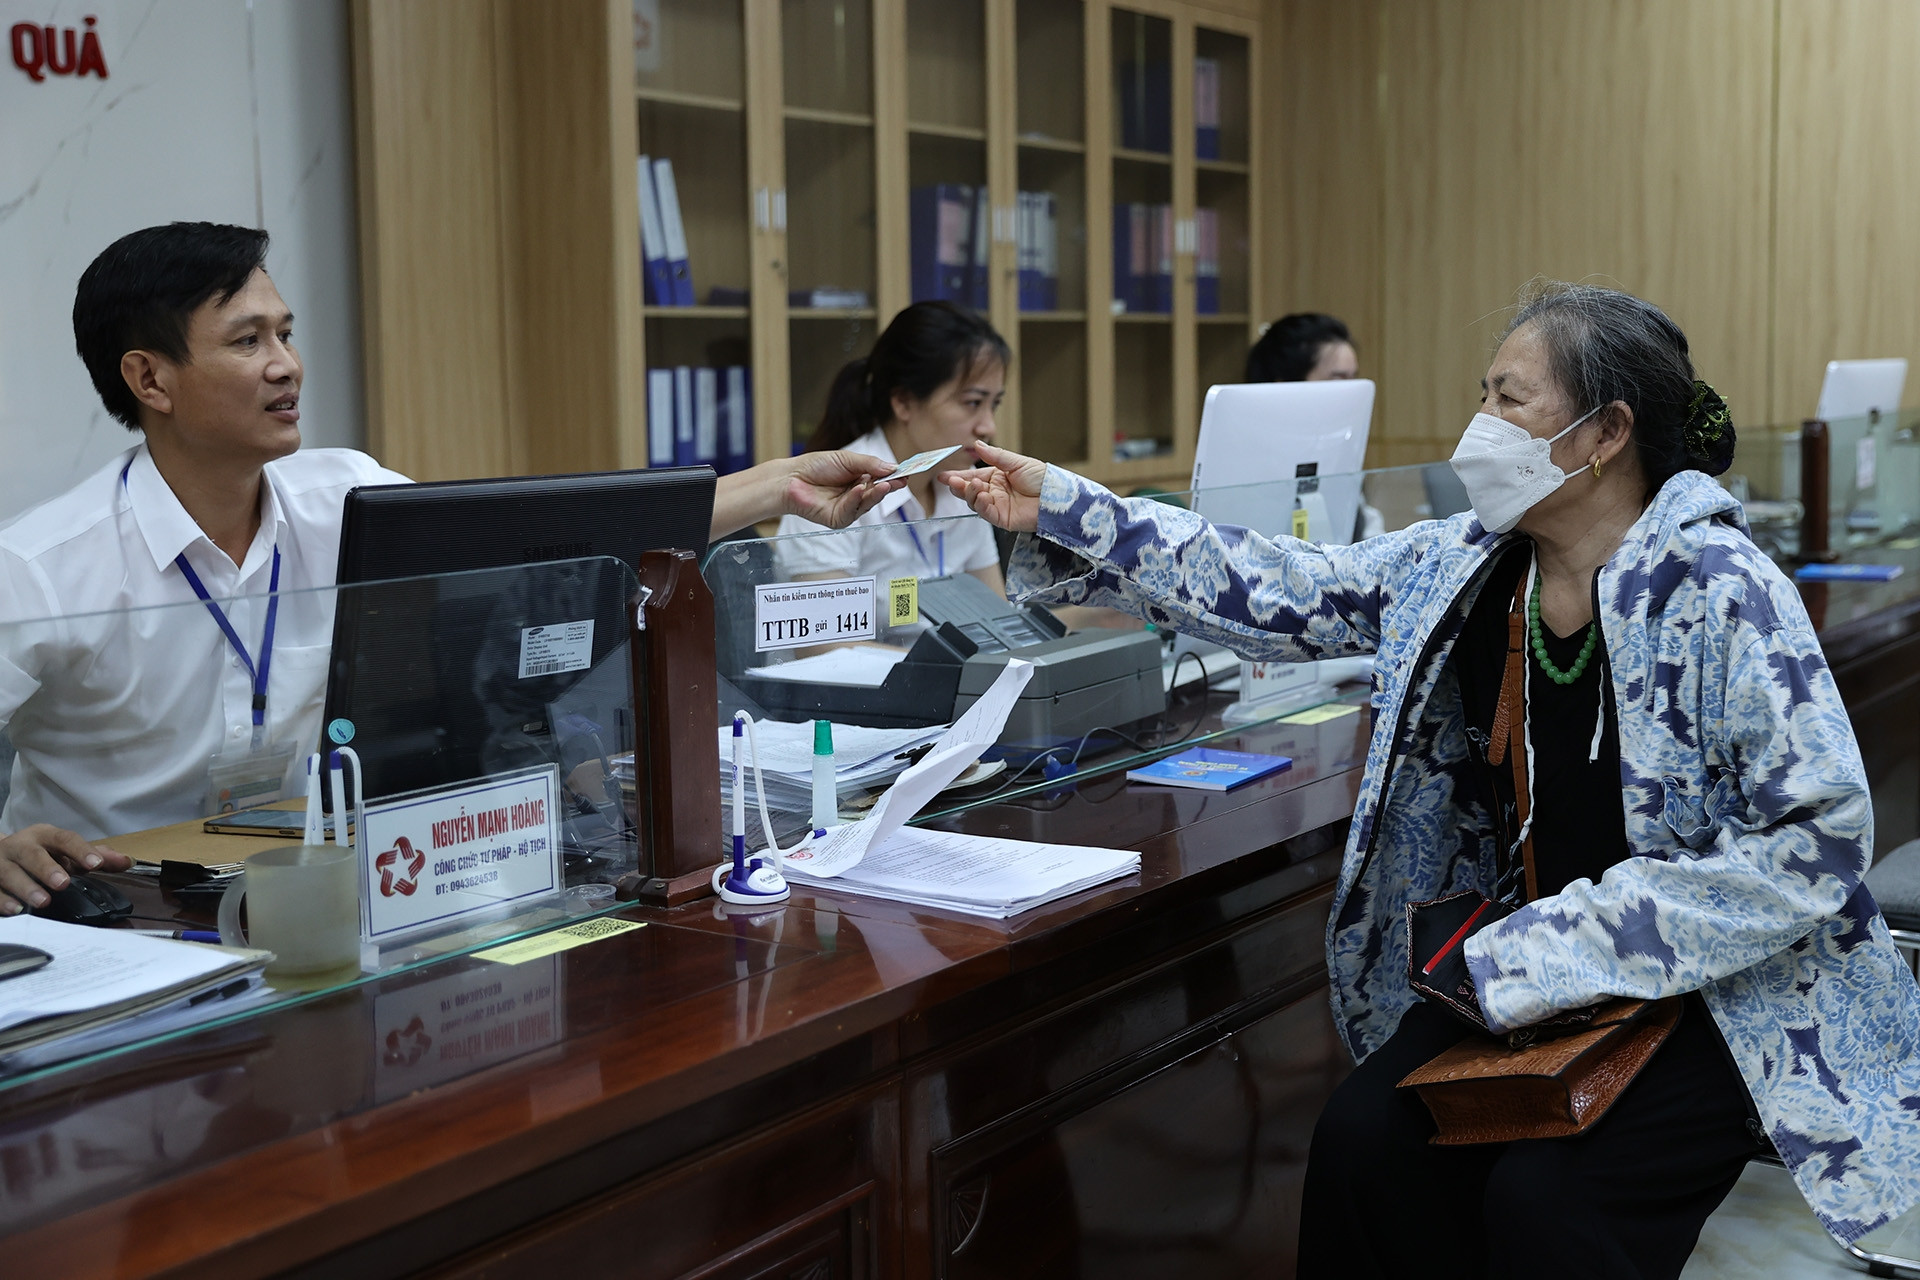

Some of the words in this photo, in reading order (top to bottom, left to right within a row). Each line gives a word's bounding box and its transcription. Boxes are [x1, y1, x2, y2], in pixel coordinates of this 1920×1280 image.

[10, 17, 108, 82] QUẢ
[782, 593, 790, 602] tin
[792, 589, 807, 601] kiểm
[808, 591, 817, 599] tra
[818, 589, 834, 600] thông
[836, 588, 844, 596] tin
[845, 587, 858, 595] thuê
[859, 586, 869, 595] bao
[762, 617, 810, 641] TTTB
[836, 611, 868, 633] 1414
[432, 806, 475, 849] NGUYỄN
[477, 807, 509, 842] MẠNH
[511, 797, 545, 831] HOÀNG
[434, 858, 456, 876] CÔNG
[458, 851, 478, 871] CHỨC
[480, 850, 490, 863] TƯ
[492, 844, 512, 863] PHÁP
[518, 839, 529, 857] HỘ
[530, 837, 546, 855] TỊCH
[435, 883, 449, 896] ĐT:
[450, 870, 498, 892] 0943624538
